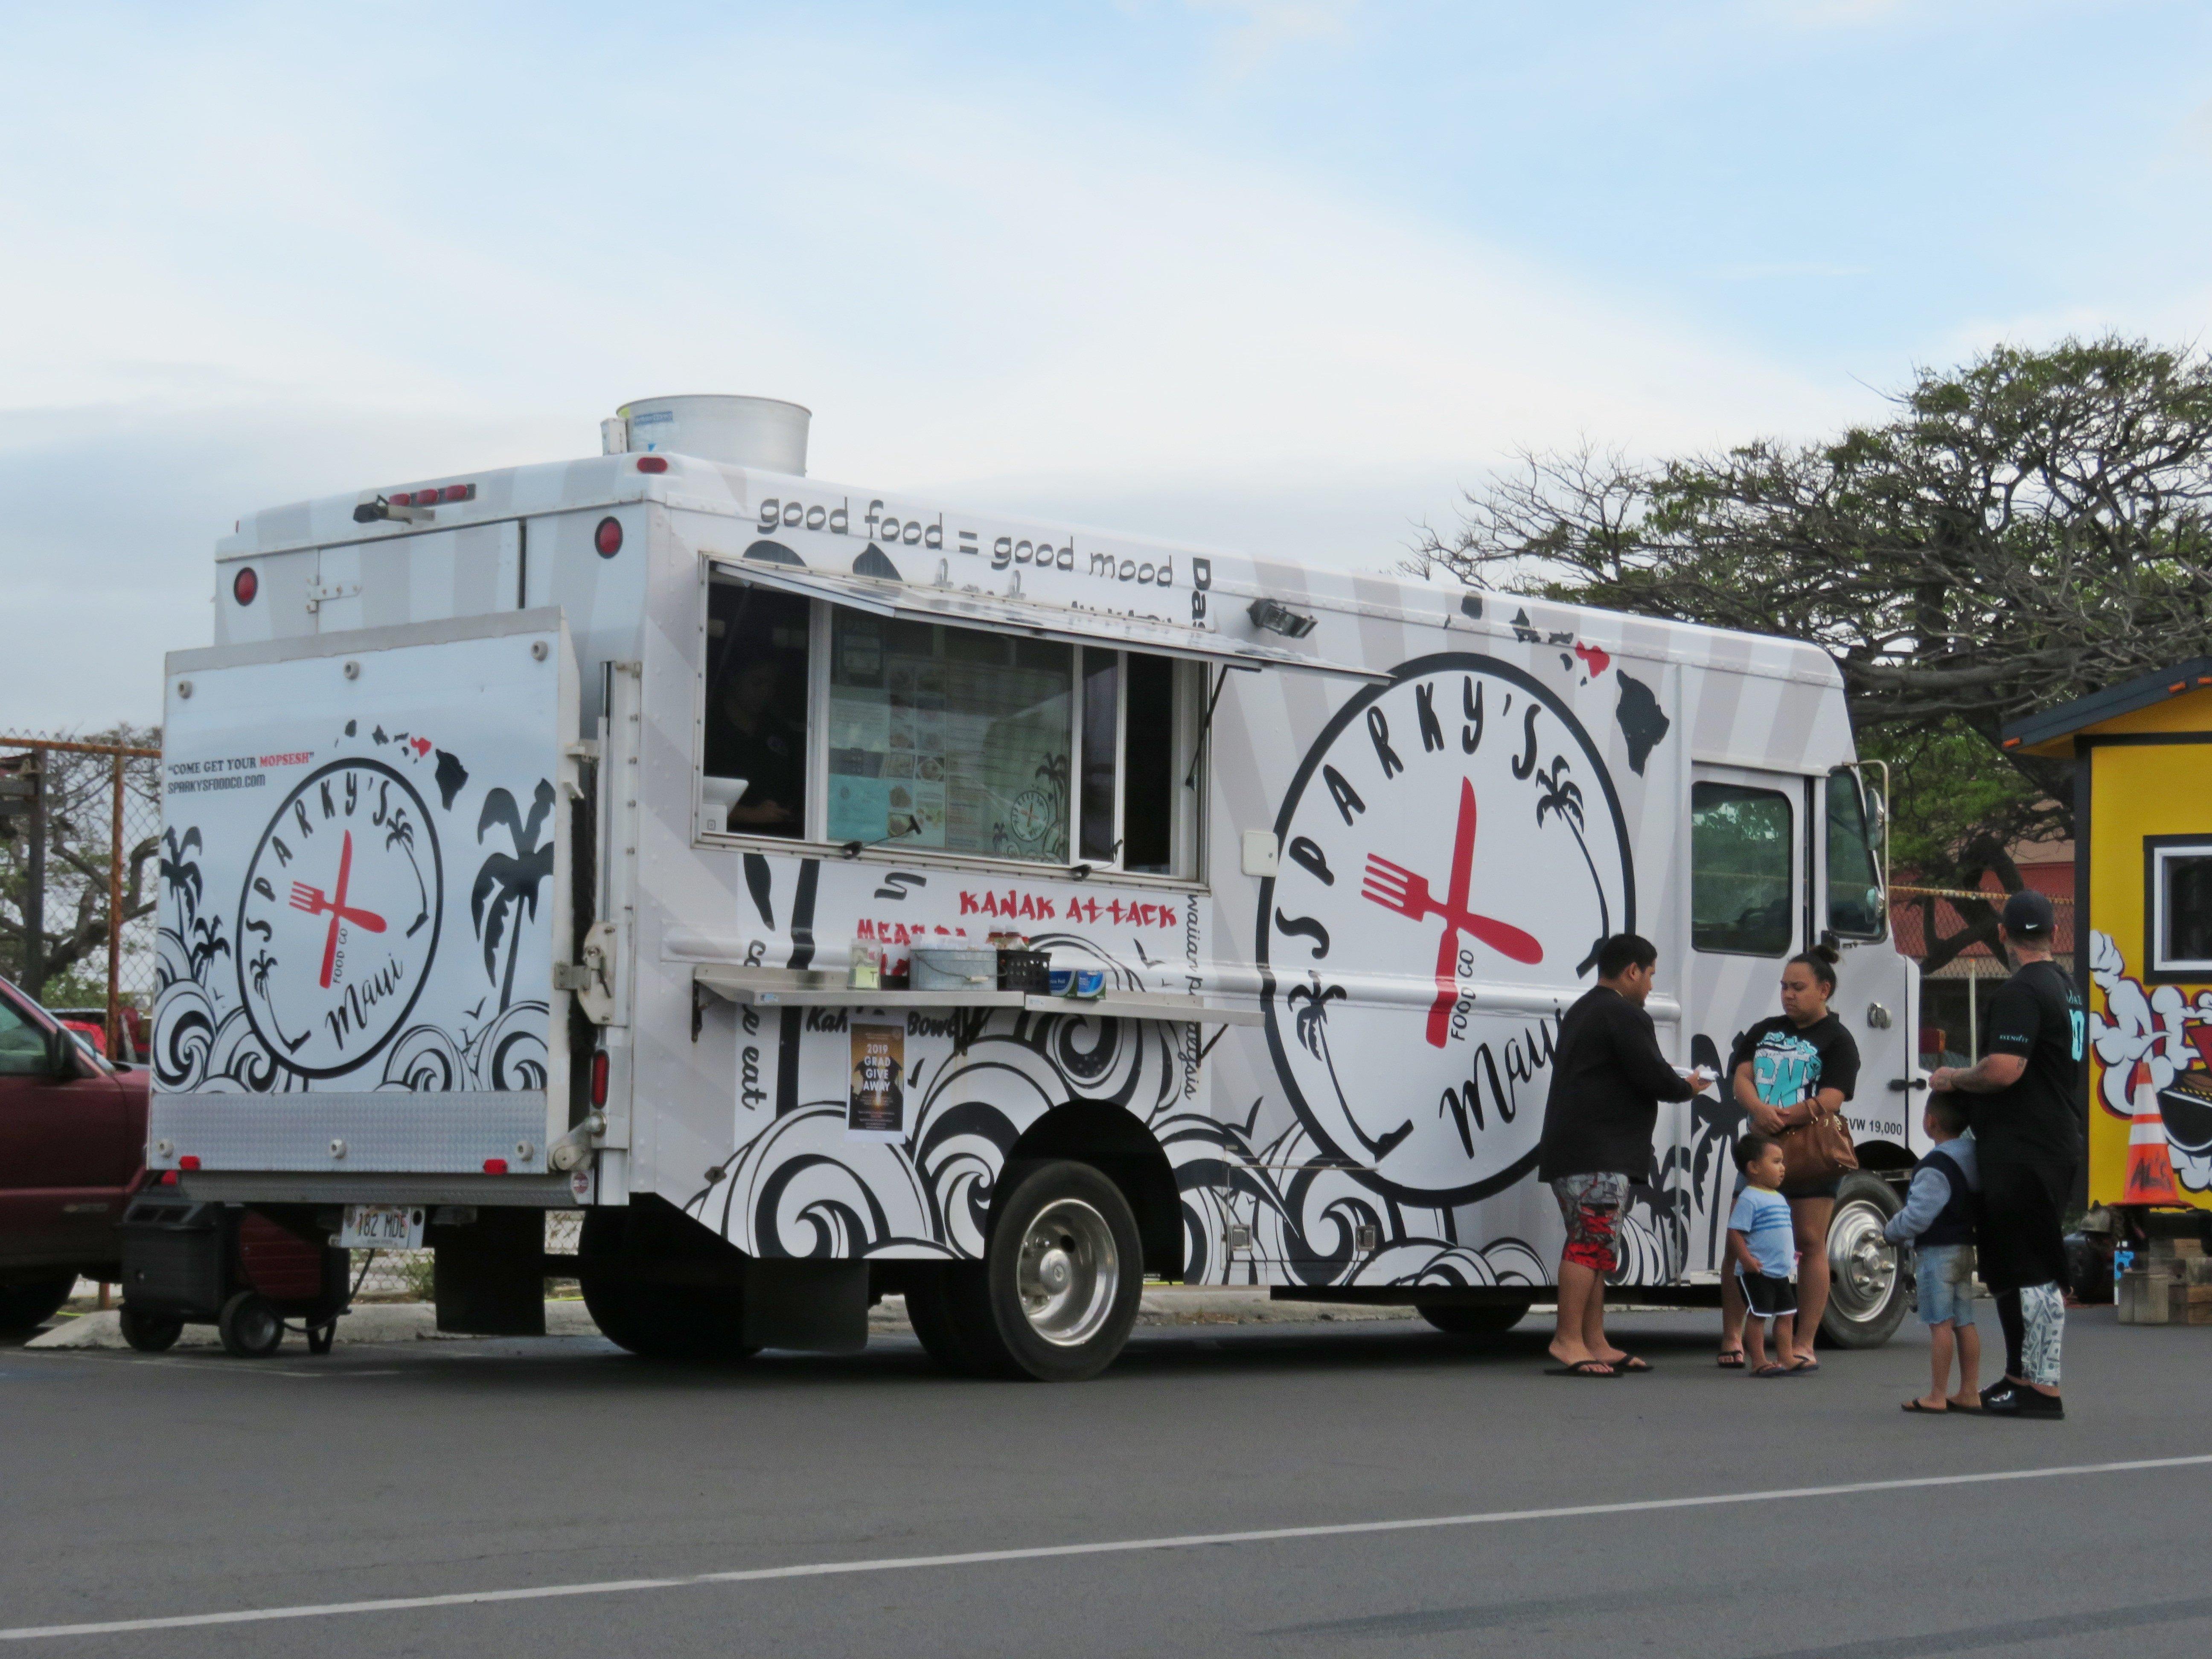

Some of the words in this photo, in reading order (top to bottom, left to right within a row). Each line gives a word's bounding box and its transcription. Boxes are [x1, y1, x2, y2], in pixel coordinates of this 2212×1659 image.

[757, 496, 849, 535] good
[864, 499, 943, 550] food
[991, 536, 1074, 571] good
[1089, 554, 1173, 588] mood
[204, 760, 223, 773] GET
[227, 757, 257, 772] YOUR
[1275, 676, 1541, 959] SPARKY'S
[246, 771, 390, 943] SPARKY'S
[959, 889, 1056, 921] KANAK
[333, 951, 345, 984] FOOD
[339, 928, 348, 944] CO
[1458, 949, 1475, 978] CO
[325, 952, 403, 1051] Maui
[1451, 987, 1476, 1041] FOOD
[864, 1056, 891, 1067] GRAD
[867, 1044, 889, 1054] 2019
[741, 1045, 768, 1111] eat
[863, 1080, 891, 1091] AWAY
[866, 1068, 889, 1079] GIVE
[1848, 1118, 1866, 1131] VW
[1869, 1120, 1902, 1136] 19,000
